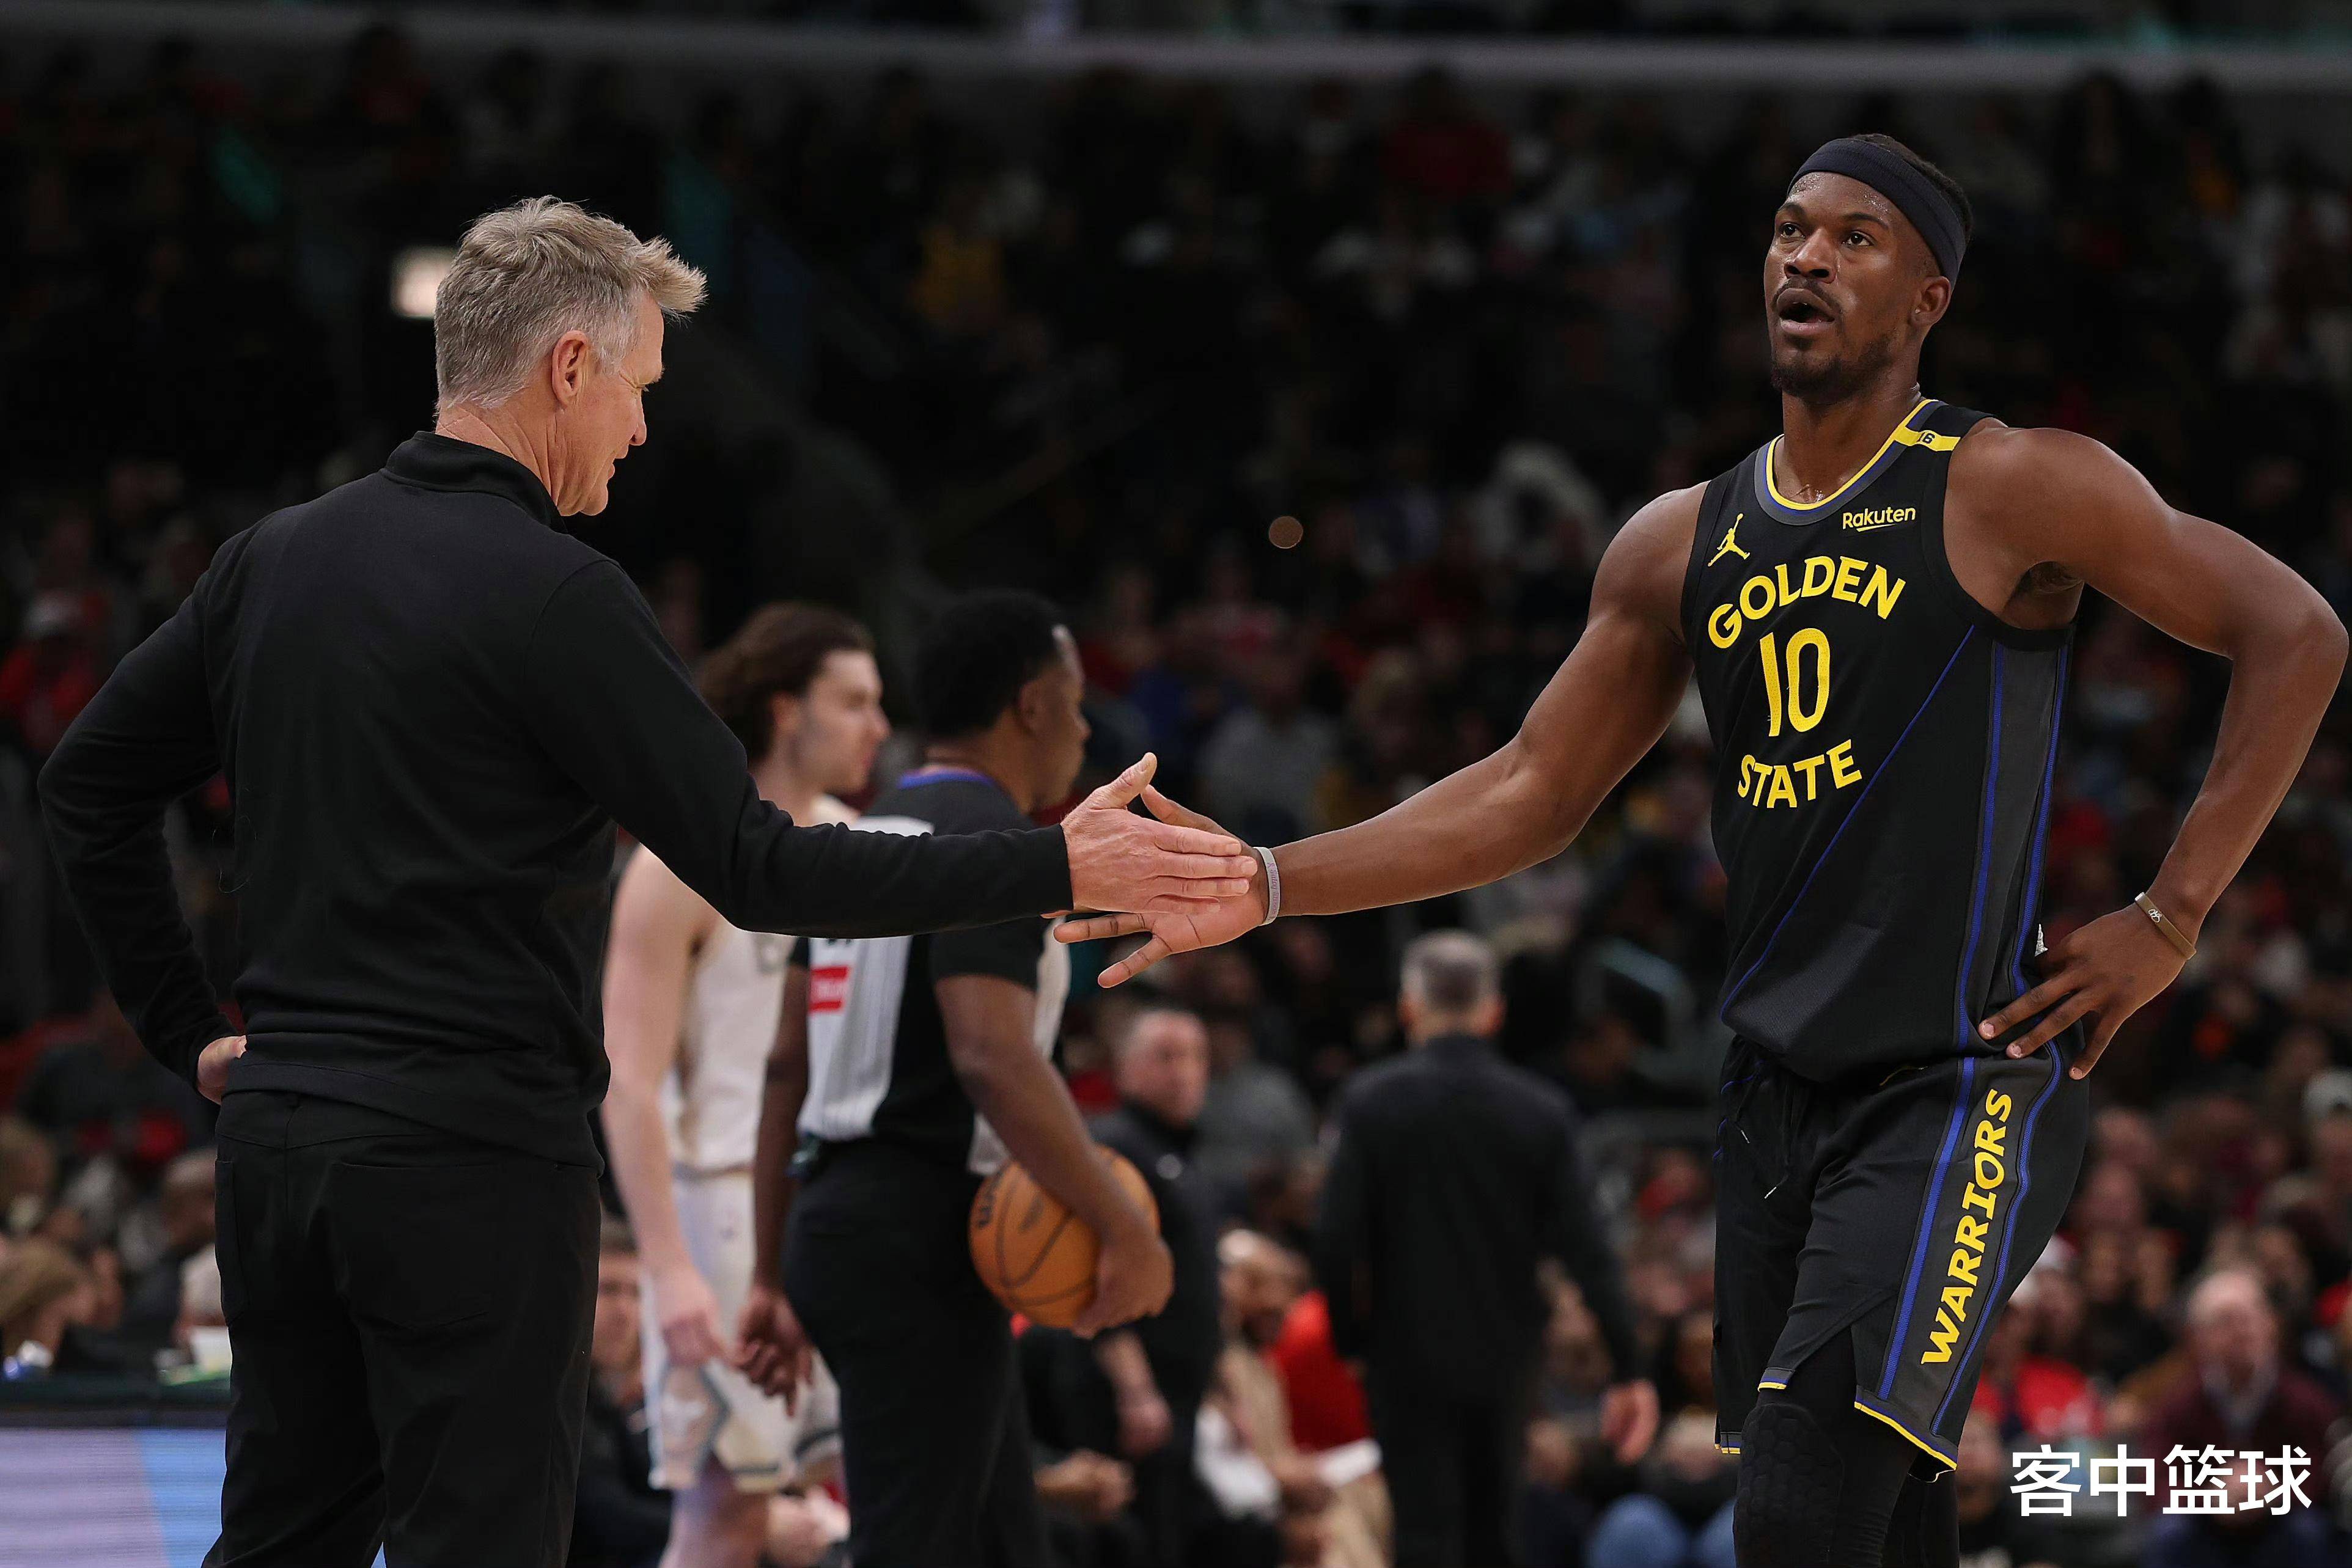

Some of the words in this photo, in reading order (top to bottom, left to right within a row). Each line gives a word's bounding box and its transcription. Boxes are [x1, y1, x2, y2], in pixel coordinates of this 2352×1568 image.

[1842, 507, 1916, 530] Rakuten
[1708, 555, 1906, 649] GOLDEN
[1760, 628, 1831, 737] 10
[1737, 739, 1862, 808] STATE
[1921, 1088, 2012, 1365] WARRIORS
